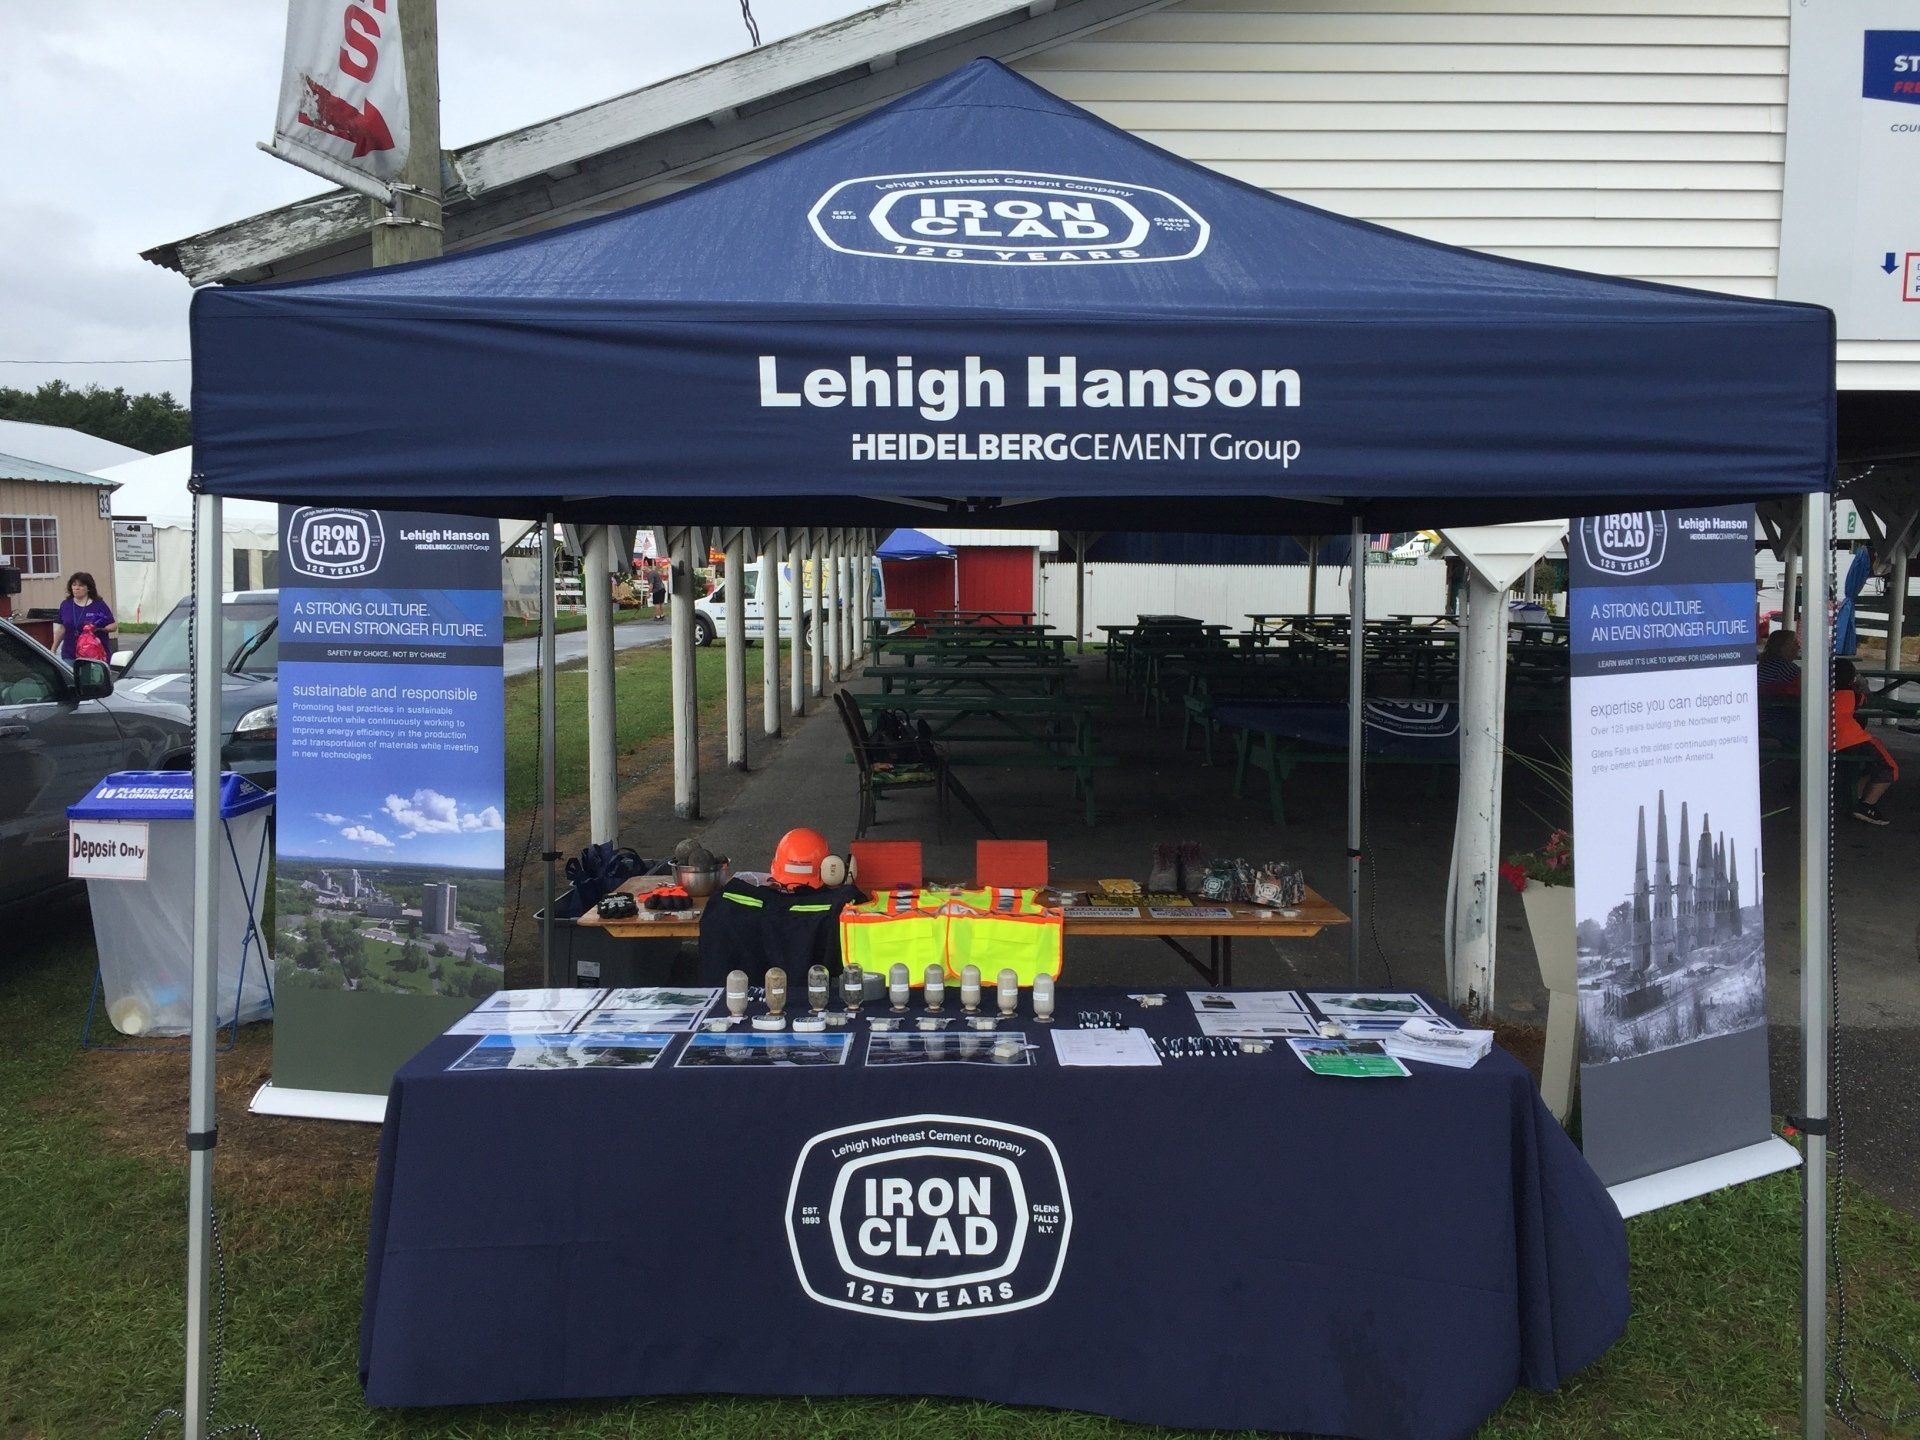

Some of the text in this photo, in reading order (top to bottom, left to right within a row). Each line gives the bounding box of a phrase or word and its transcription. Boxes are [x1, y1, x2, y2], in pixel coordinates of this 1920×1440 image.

[1893, 55, 1920, 72] ST
[1891, 124, 1920, 132] COU
[875, 177, 1134, 198] Lehigh Northeast Cement Company
[920, 198, 1096, 221] IRON
[911, 217, 1110, 239] CLAD
[894, 245, 1140, 261] 125 YEARS
[759, 356, 1301, 421] Lehigh Hanson
[100, 494, 110, 513] 33
[1604, 512, 1644, 530] IRON
[1678, 517, 1711, 532] Lehigh
[1713, 517, 1748, 530] Hanson
[1849, 515, 1855, 531] 2
[313, 525, 358, 541] IRON
[400, 529, 490, 543] Lehigh Hanson
[1603, 529, 1645, 548] CLAD
[310, 540, 360, 556] CLAD
[306, 564, 366, 575] 125 YEARS
[1600, 557, 1651, 571] 125 YEARS
[293, 602, 431, 617] A STRONG CULTURE.
[1590, 600, 1705, 620] A STRONG CULTURE.
[293, 621, 487, 637] AN EVEN STRONGER FUTURE.
[1591, 619, 1749, 642] AN EVEN STRONGER FUTURE.
[327, 649, 352, 657] SAFETY
[419, 651, 447, 659] CHANCE
[1598, 660, 1617, 668] LEARN
[1617, 659, 1634, 667] WHAT
[1646, 657, 1658, 665] LIKE
[1659, 656, 1667, 664] TO
[1667, 655, 1687, 663] WORK
[1688, 654, 1700, 662] FOR
[1718, 652, 1741, 660] HANSON
[292, 684, 478, 702] sustainable and responsible
[292, 702, 453, 715] Promoting best practices in sustainable
[1591, 691, 1749, 719] expertise you can depend on
[292, 715, 465, 729] construction while continuously working to
[1591, 726, 1608, 736] Over
[1611, 724, 1624, 734] 125
[1625, 724, 1644, 734] years
[1646, 719, 1672, 731] building
[1673, 719, 1686, 728] the
[1720, 714, 1741, 724] region
[292, 727, 325, 736] improve
[326, 728, 354, 737] energy
[356, 728, 395, 739] efficiency
[408, 730, 422, 738] the
[424, 730, 467, 740] production
[292, 738, 479, 753] and transportation of materials while investing
[1632, 746, 1639, 754] is
[1640, 744, 1651, 753] the
[1674, 738, 1717, 750] continuously
[292, 750, 299, 758] in
[321, 750, 373, 761] technologies.
[1610, 760, 1636, 771] cement
[1656, 756, 1662, 765] in
[1663, 754, 1683, 764] North
[115, 792, 168, 800] ALUMINUM
[116, 787, 157, 795] PLASTIC
[73, 832, 145, 863] Deposit Only
[832, 1129, 1026, 1158] Lehigh Northeast Cement Company
[865, 1176, 991, 1217] IRON
[802, 1207, 820, 1215] EST.
[1033, 1204, 1060, 1214] GLENS
[801, 1216, 821, 1225] 1893
[1033, 1214, 1059, 1224] FALLS
[858, 1216, 998, 1256] CLAD
[1038, 1225, 1054, 1234] N.Y.
[846, 1281, 1014, 1309] 125 YEARS
